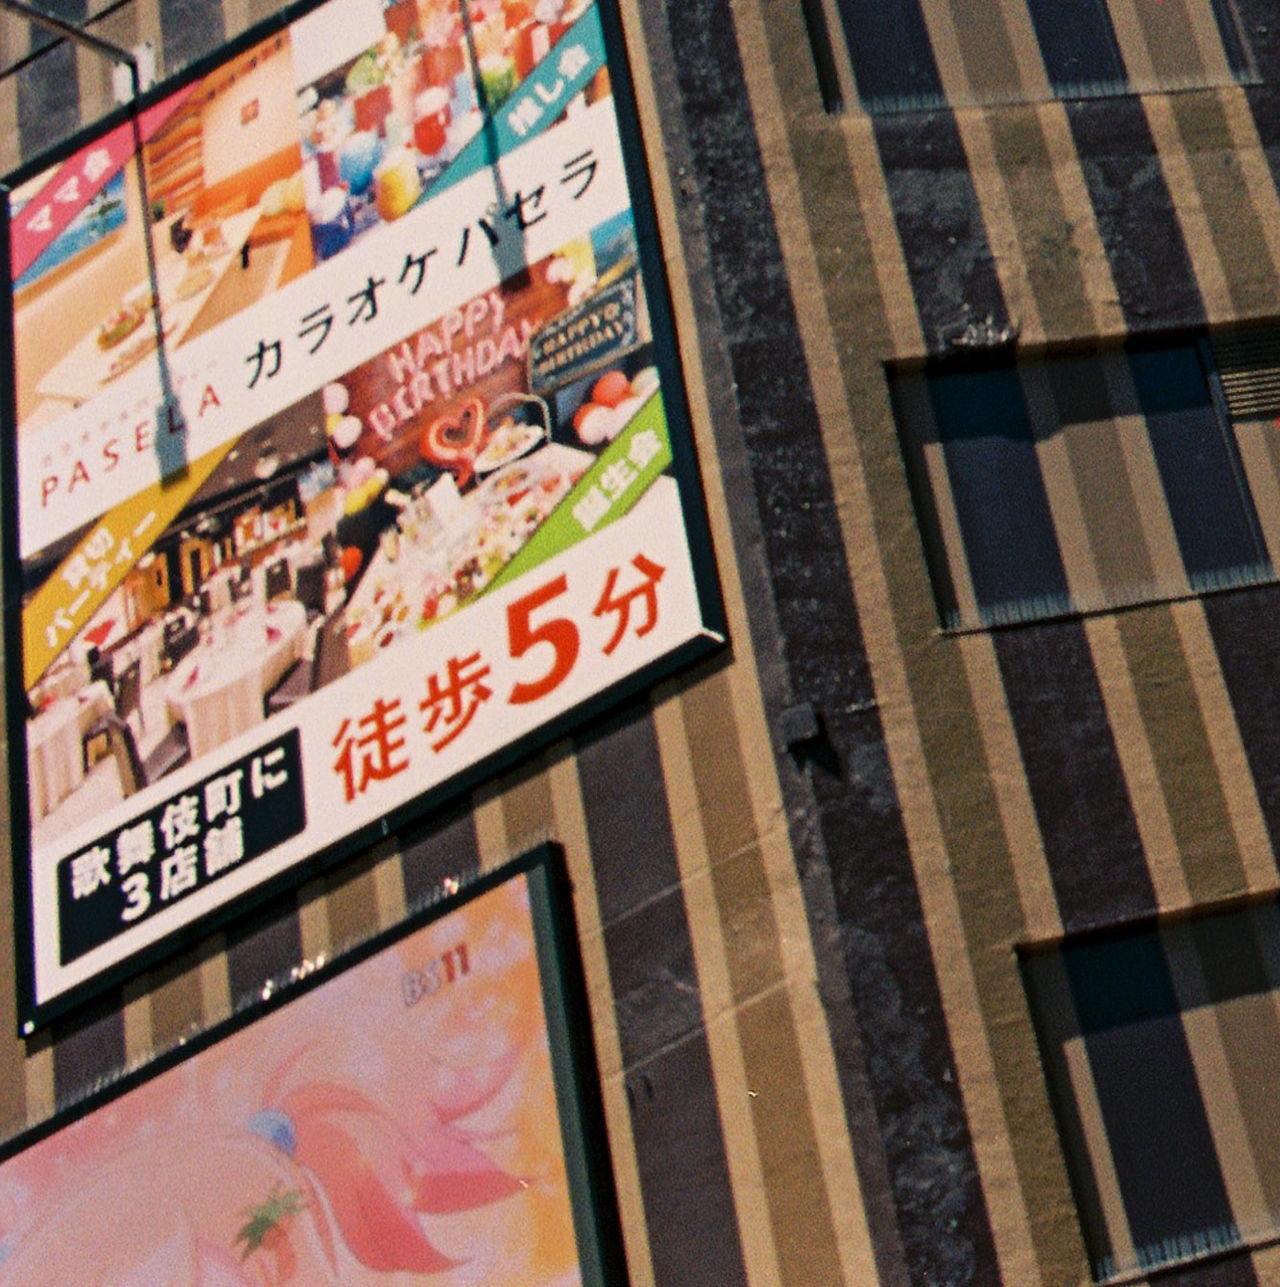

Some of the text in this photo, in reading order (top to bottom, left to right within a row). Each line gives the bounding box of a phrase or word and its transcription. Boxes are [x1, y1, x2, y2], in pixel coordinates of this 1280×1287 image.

[246, 148, 601, 390] カラオケパセラ
[388, 292, 506, 384] HAPPY
[40, 383, 222, 509] PASELA
[331, 553, 668, 804] 徒歩5分
[70, 746, 289, 900] 歌舞伎町に
[121, 815, 245, 922] 3店舗
